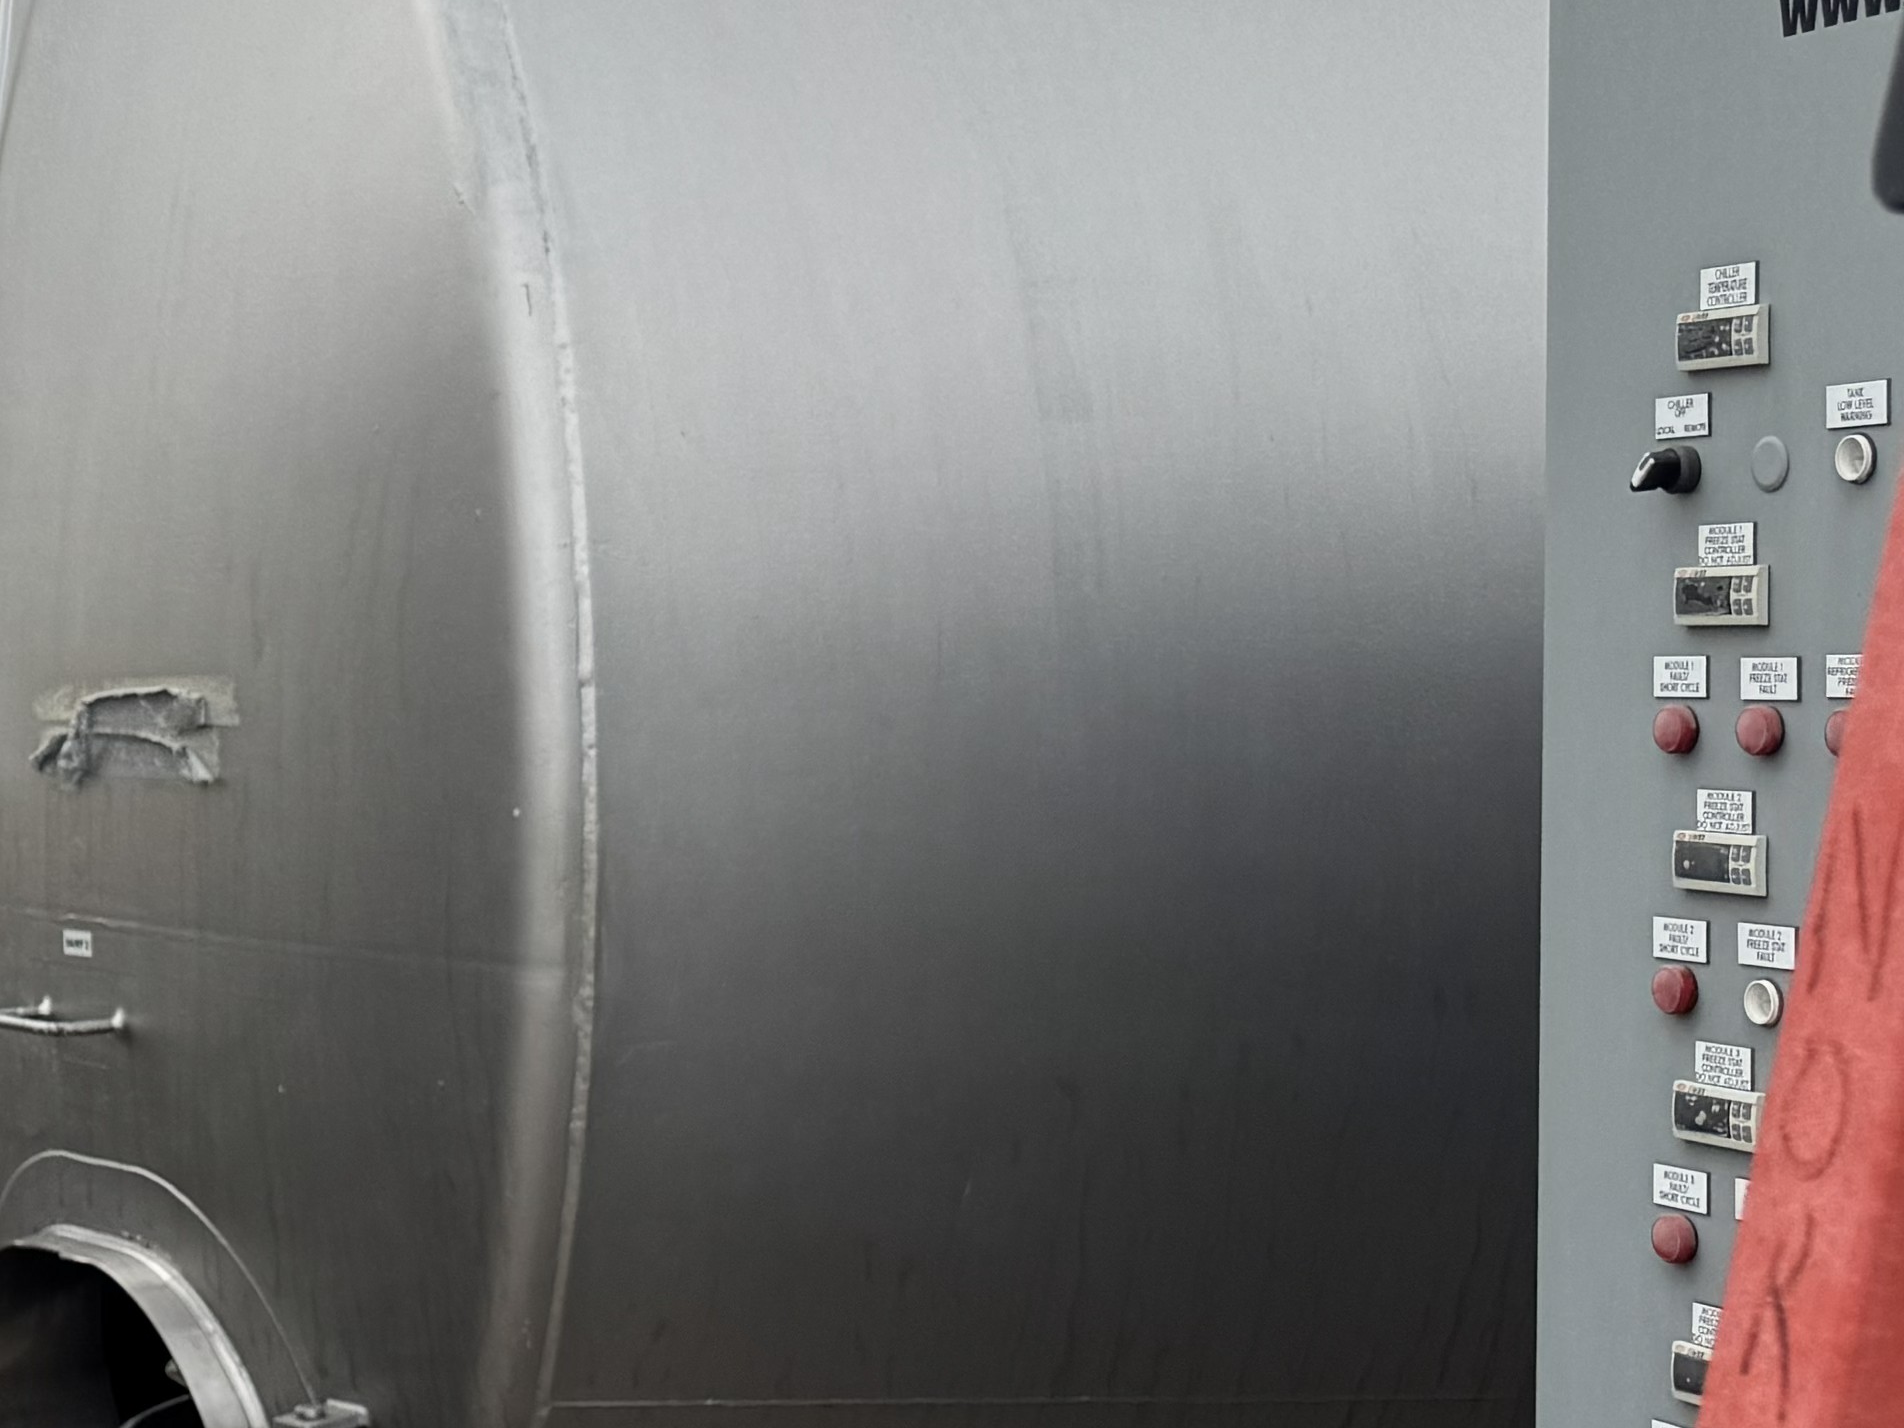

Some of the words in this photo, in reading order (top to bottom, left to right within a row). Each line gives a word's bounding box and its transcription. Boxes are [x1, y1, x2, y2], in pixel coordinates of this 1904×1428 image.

[1715, 266, 1740, 280] CHILLER
[1708, 278, 1747, 294] TEMPERATURE
[1707, 292, 1747, 306] CONTROLLER
[1668, 398, 1694, 409] CHILLER
[1837, 401, 1853, 411] LOW
[1855, 398, 1874, 409] LEVEL
[1709, 525, 1736, 534] MODULE
[1705, 536, 1728, 544] FREEZE
[1704, 545, 1745, 555] CONTROLLER
[1707, 792, 1734, 801] MODULE
[1704, 801, 1727, 810] FREEZE
[1703, 811, 1744, 822] CONTROLLER
[1749, 929, 1775, 940] MODULE
[1702, 1063, 1744, 1077] CONTROLLER
